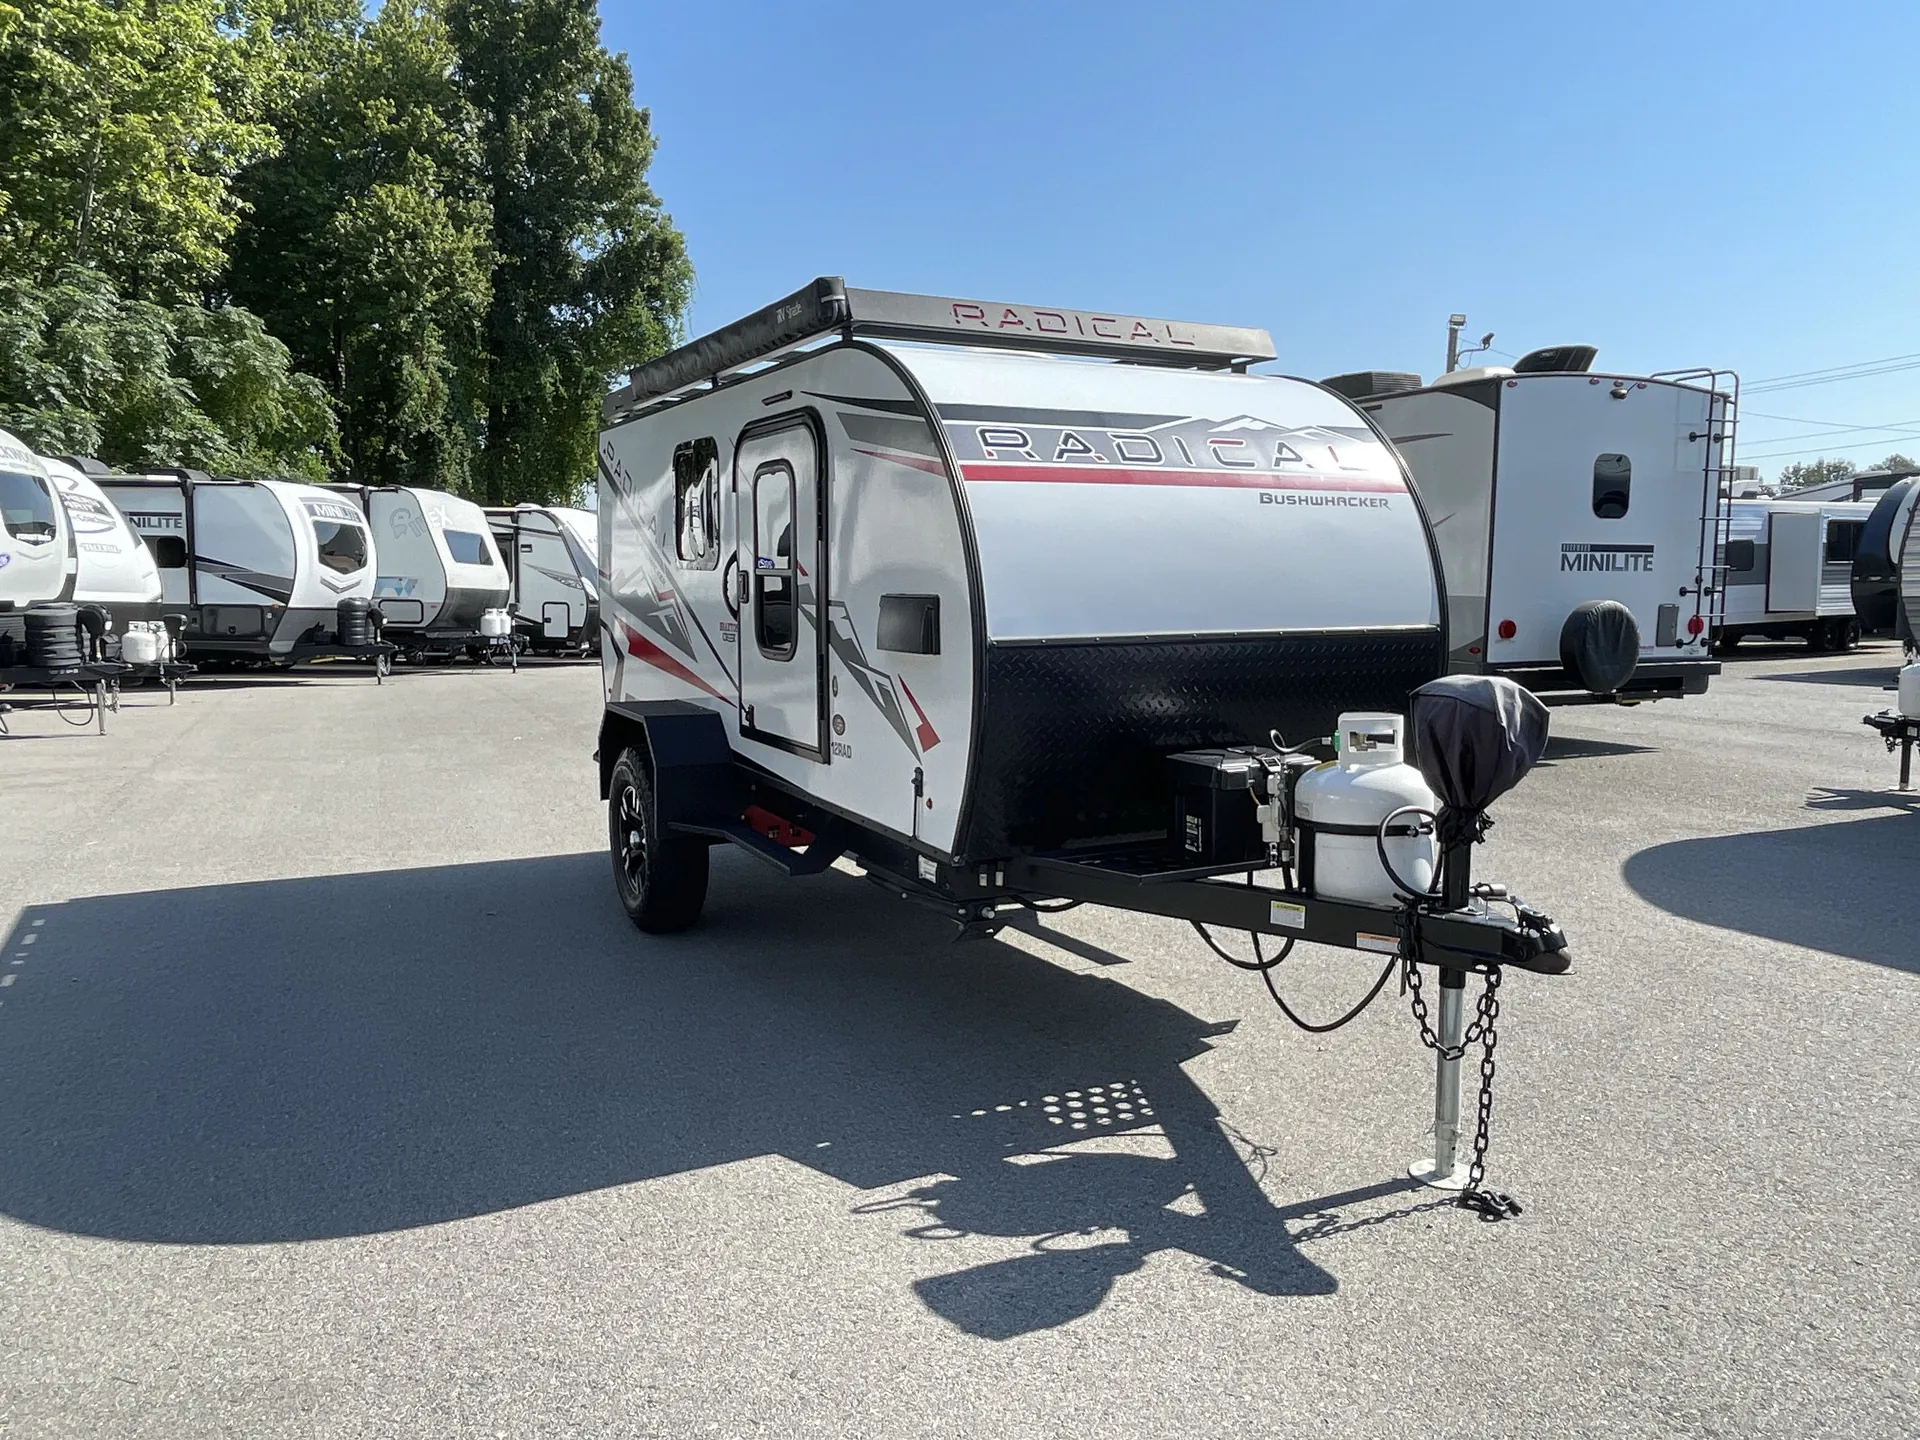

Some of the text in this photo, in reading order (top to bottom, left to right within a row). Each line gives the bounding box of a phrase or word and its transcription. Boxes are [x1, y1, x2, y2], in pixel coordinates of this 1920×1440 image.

[951, 302, 1196, 346] RADICAL
[975, 425, 1370, 472] RADICAL
[1258, 491, 1392, 511] BUSHWHACKER
[313, 503, 361, 522] MINILITE
[128, 517, 184, 529] NILITE
[1559, 553, 1654, 572] MINILITE
